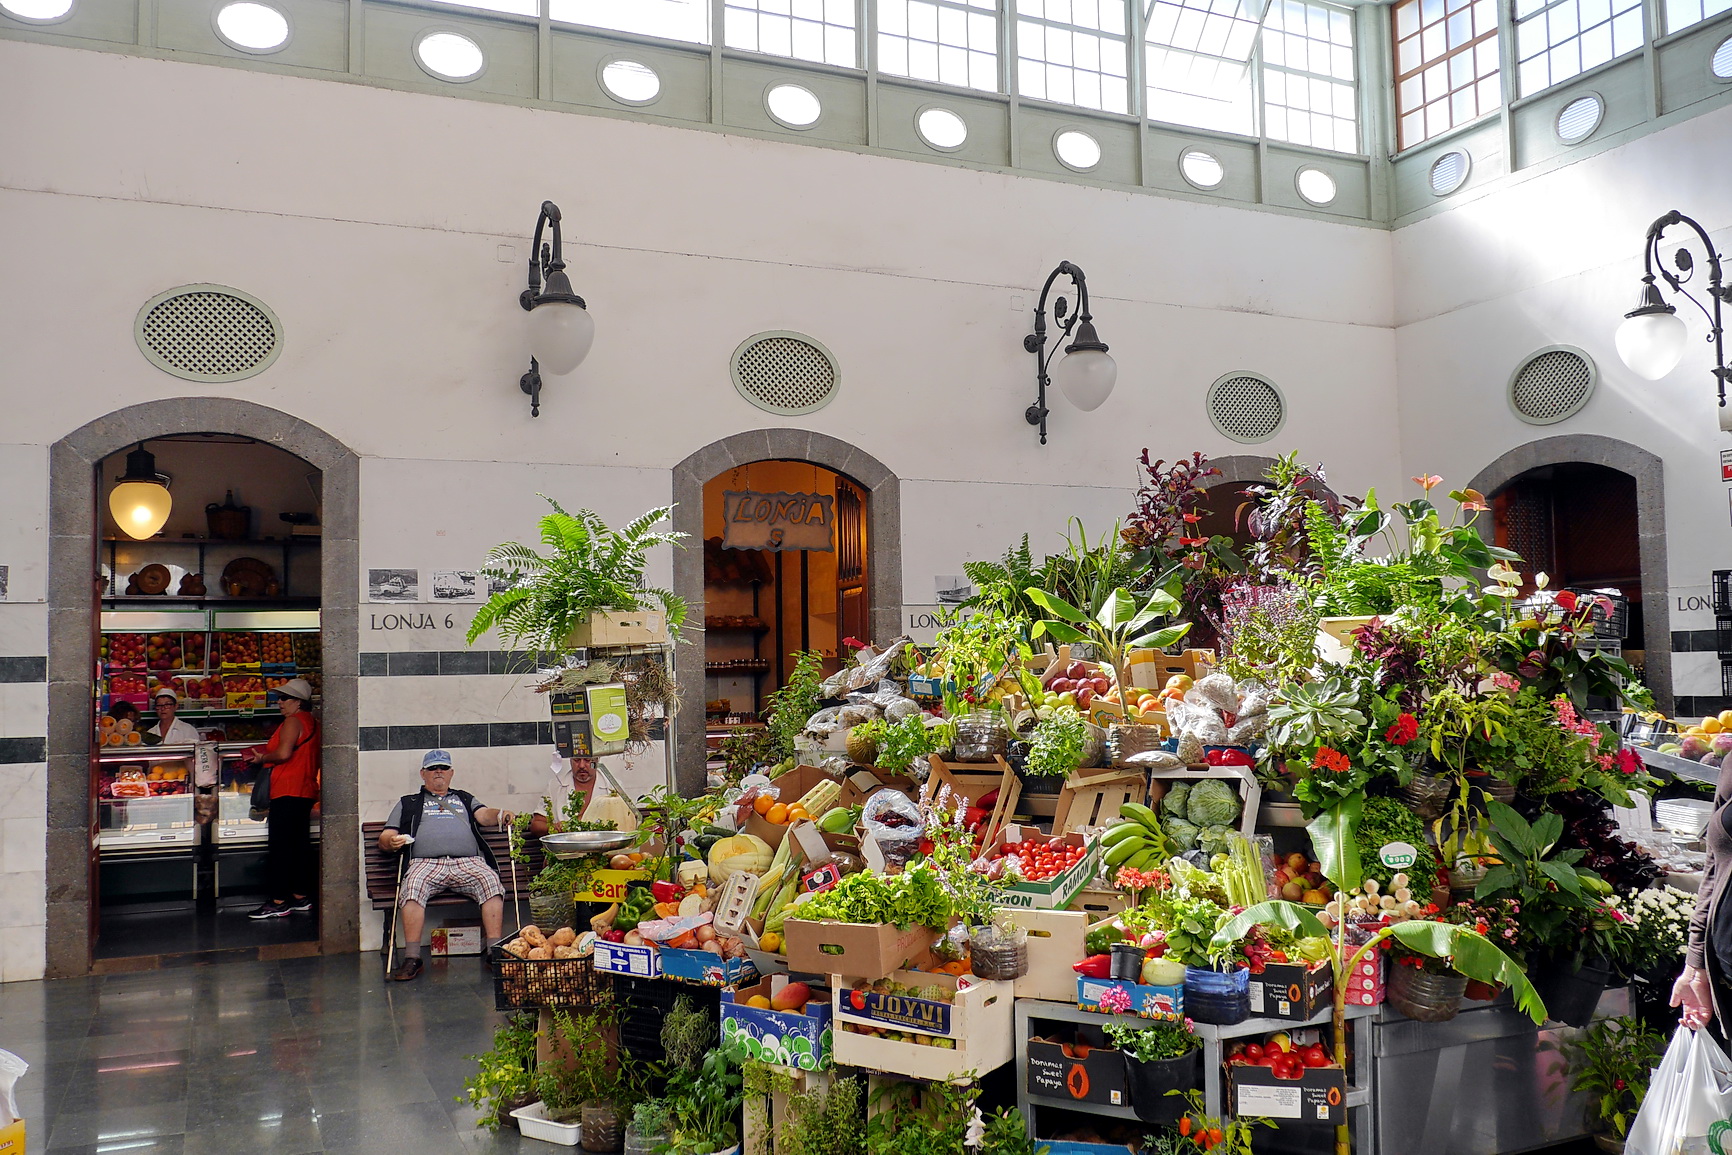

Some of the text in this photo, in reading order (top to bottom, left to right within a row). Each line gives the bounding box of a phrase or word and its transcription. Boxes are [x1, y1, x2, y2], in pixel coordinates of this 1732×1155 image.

[371, 613, 454, 631] LONJA 6
[1062, 858, 1091, 900] RAMON
[870, 994, 943, 1023] JOYVI
[1036, 1075, 1063, 1089] Papaya
